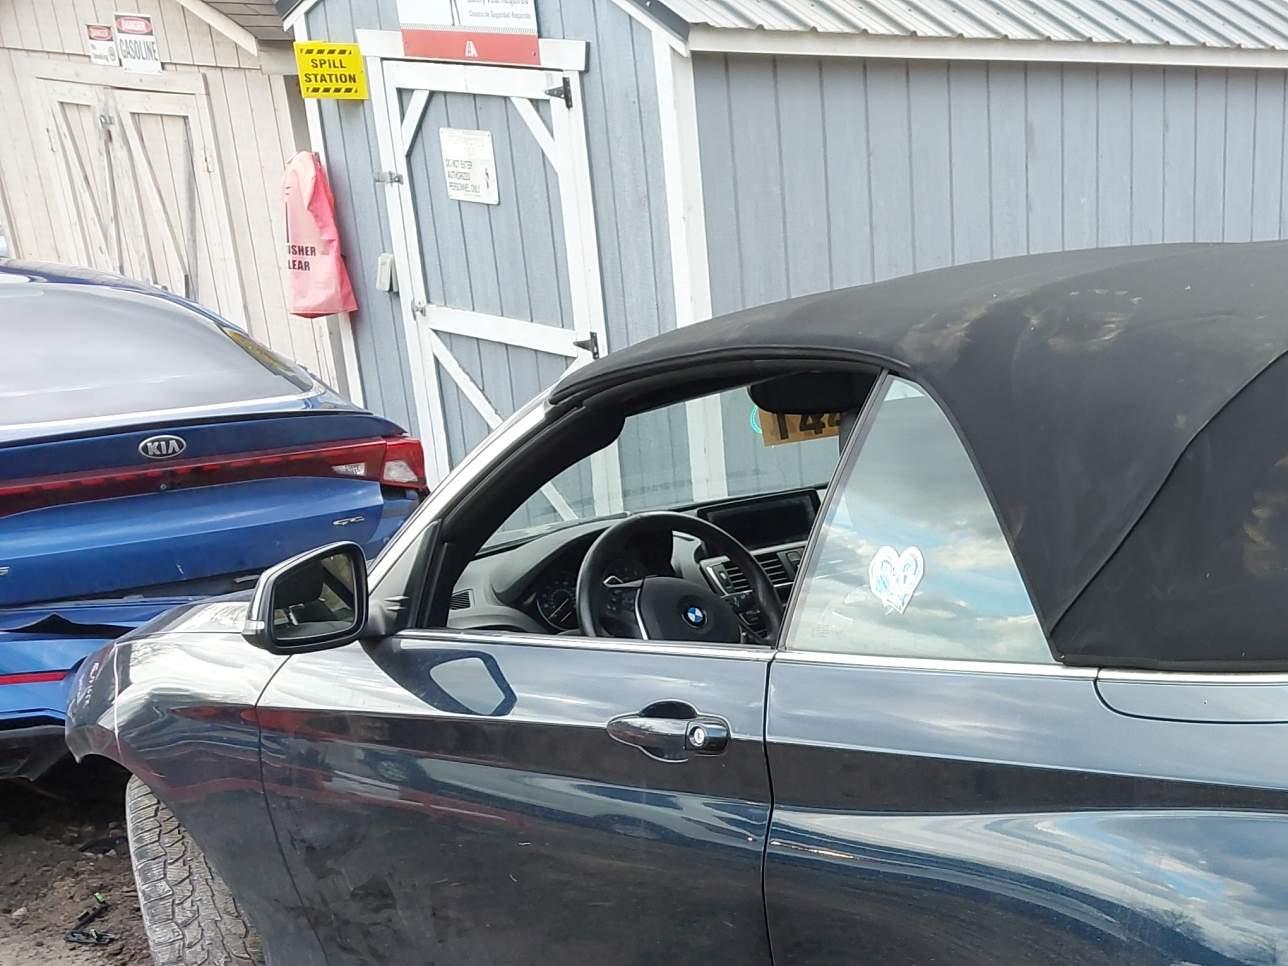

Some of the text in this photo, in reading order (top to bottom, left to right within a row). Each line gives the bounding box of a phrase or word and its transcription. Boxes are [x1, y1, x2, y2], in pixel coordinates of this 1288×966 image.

[119, 38, 159, 62] GASOLINE
[310, 58, 347, 69] SPILL
[304, 72, 357, 84] STATION
[146, 439, 180, 456] KIA
